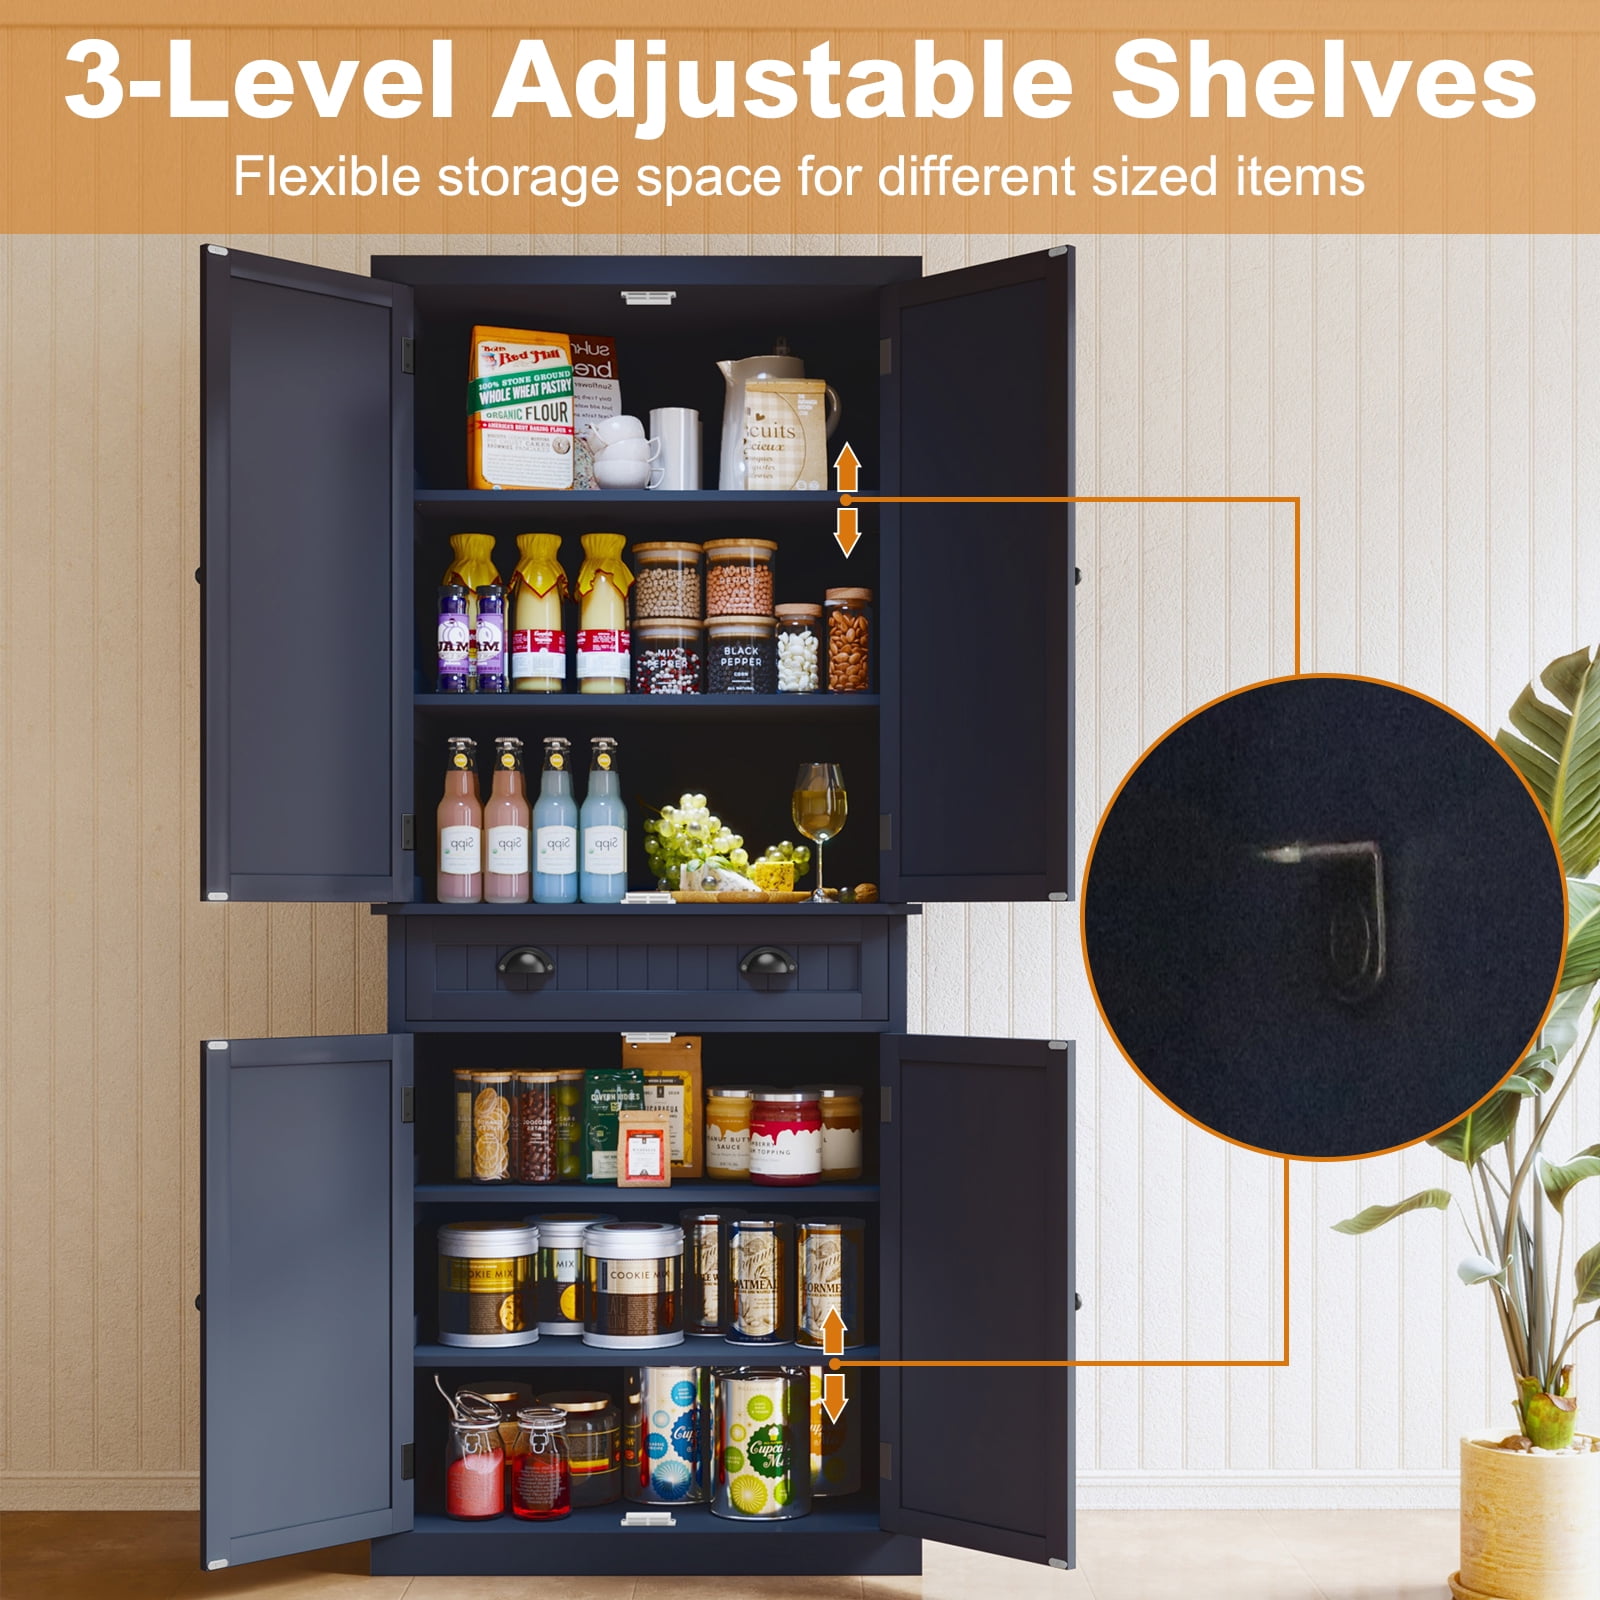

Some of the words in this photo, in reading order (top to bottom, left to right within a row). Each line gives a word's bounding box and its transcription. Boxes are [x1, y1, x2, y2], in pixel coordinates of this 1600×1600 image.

[499, 350, 529, 367] Red
[530, 349, 561, 364] Mill
[478, 381, 500, 391] 100%
[502, 376, 532, 386] STONE
[533, 369, 571, 381] GROUND
[478, 385, 512, 406] WHOLE
[512, 382, 541, 400] WHEAT
[541, 378, 572, 395] PASTRY
[486, 408, 523, 420] ORGANIC
[525, 401, 569, 423] FLOUR
[438, 641, 469, 652] JAM
[724, 646, 759, 655] BLACK
[657, 649, 677, 657] MIX
[647, 659, 688, 668] PEPPER
[720, 657, 762, 667] PEPPER
[646, 1105, 678, 1113] ICARAGUA
[758, 1148, 791, 1156] TOPPING
[556, 1260, 575, 1268] MIX
[468, 1269, 492, 1279] OKIE
[494, 1269, 513, 1279] MIX
[610, 1271, 649, 1280] COOKIE
[807, 1282, 842, 1293] ORNME
[750, 1440, 783, 1457] Cupca
